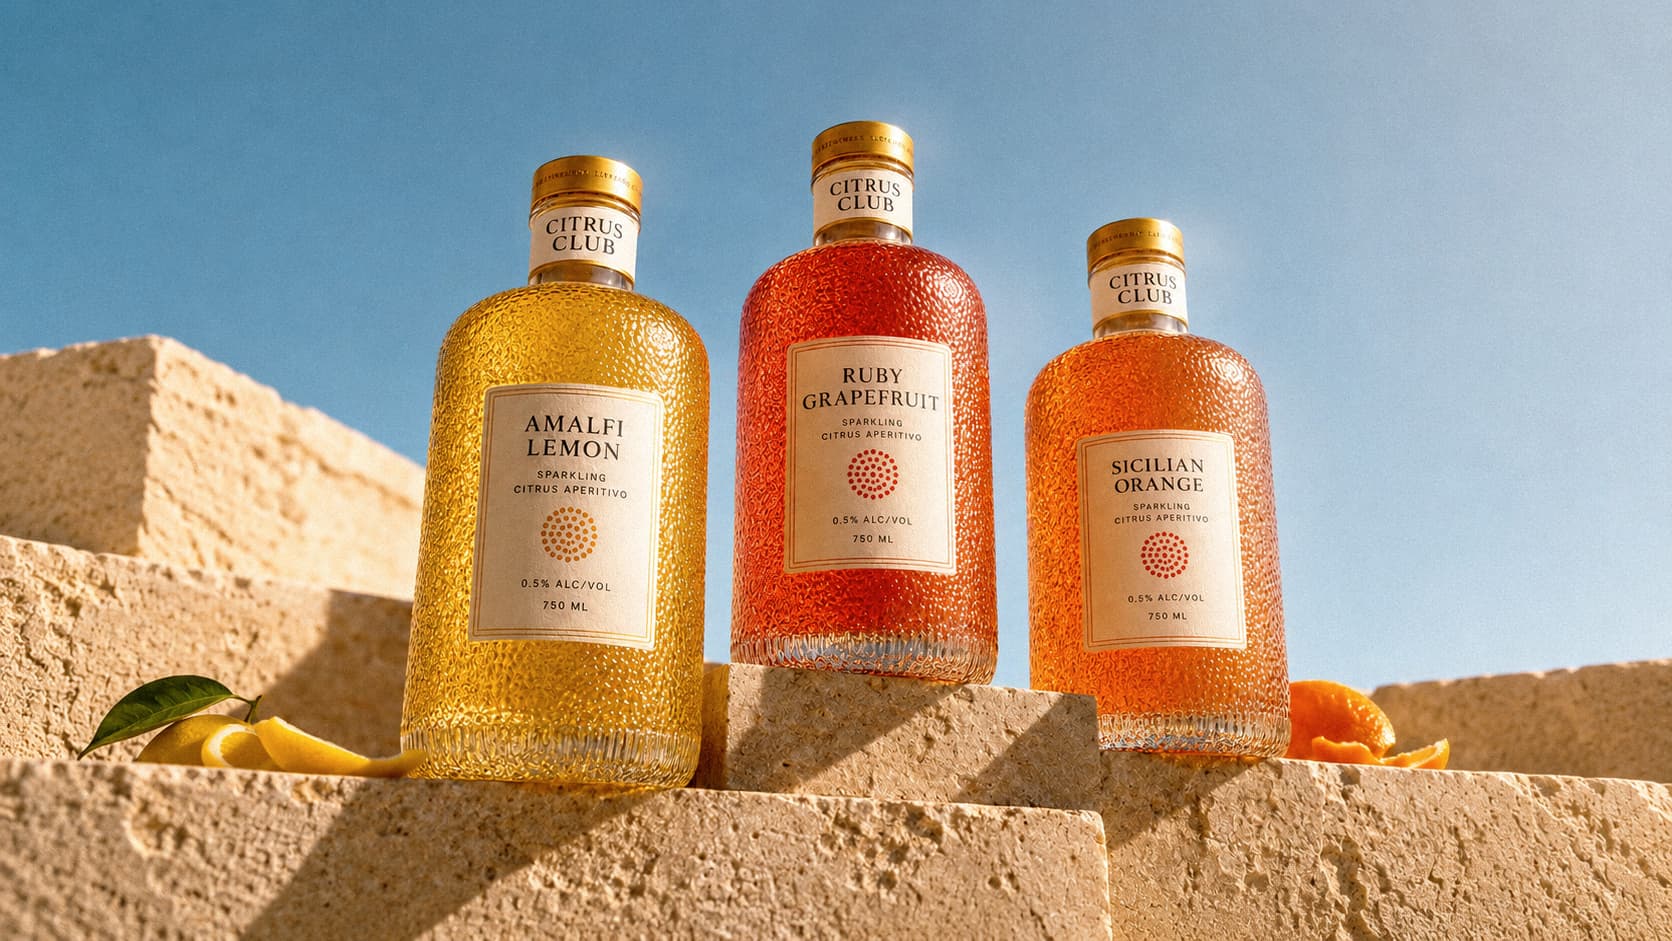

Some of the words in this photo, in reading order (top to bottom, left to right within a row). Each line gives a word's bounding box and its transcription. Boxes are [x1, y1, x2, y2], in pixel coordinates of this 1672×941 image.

[829, 178, 900, 197] CITRUS
[837, 195, 894, 212] CLUB
[546, 216, 623, 239] CITRUS
[552, 235, 615, 255] CLUB
[1109, 272, 1177, 290] CITRUS
[1118, 288, 1172, 304] CLUB
[842, 367, 903, 384] RUBY
[802, 389, 939, 411] GRAPEFRUIT
[524, 415, 624, 437] AMALFI
[842, 418, 903, 427] SPARKLING
[821, 431, 861, 441] CITRUS
[865, 431, 922, 441] APERITIVO
[527, 439, 620, 460] LEMON
[1111, 458, 1204, 475] SICILIAN
[537, 470, 606, 483] SPARKLING
[513, 484, 558, 494] CITRUS
[563, 485, 627, 499] APERITIVO
[1115, 476, 1204, 494] ORANGE
[1133, 503, 1190, 511] SPARKLING
[832, 516, 858, 525] 0.5%
[863, 515, 913, 526] ALC/VOL
[1114, 514, 1152, 525] CITRUS
[1156, 514, 1209, 523] APERITIVO
[853, 535, 873, 543] 750
[878, 535, 893, 543] ML
[521, 578, 550, 589] 0.5%
[555, 579, 611, 592] ALC/VOL
[543, 600, 565, 610] 750
[571, 601, 588, 612] ML
[1127, 594, 1153, 603] 0.5%
[1157, 594, 1204, 602] ALC/VOL
[1148, 612, 1168, 620] 750
[1172, 612, 1187, 620] ML
